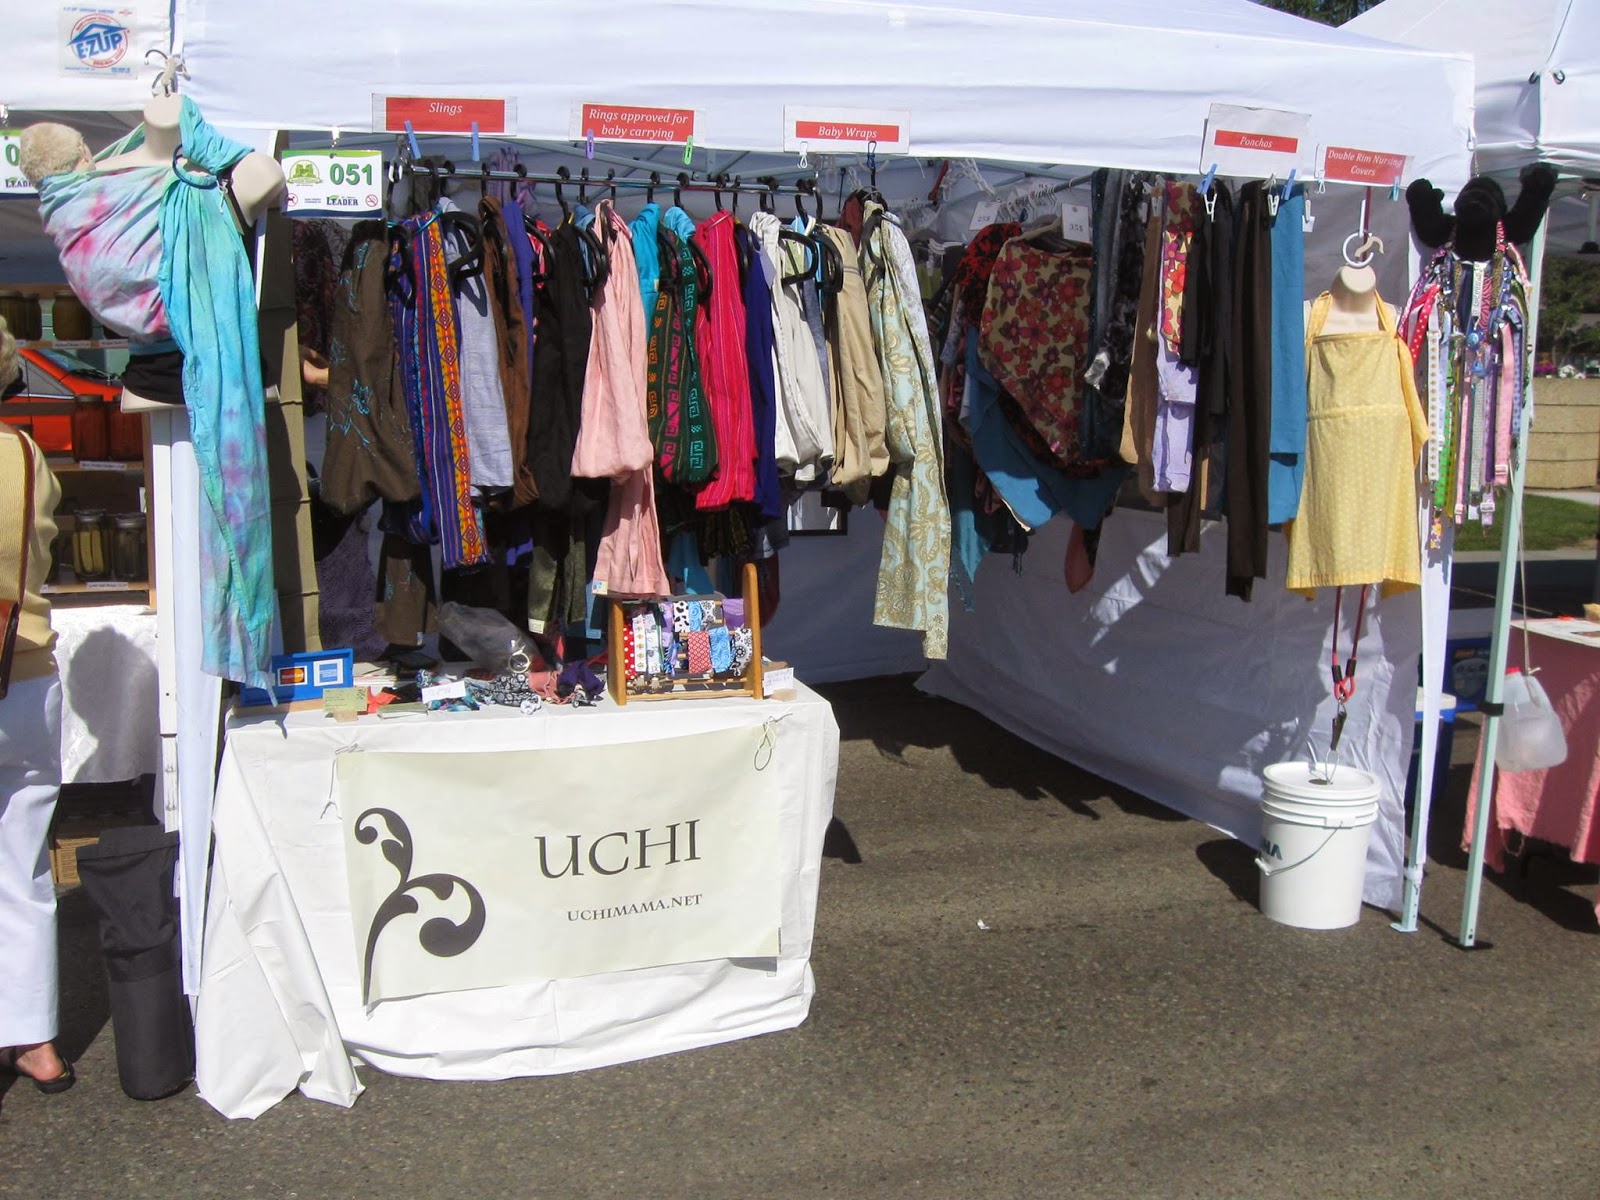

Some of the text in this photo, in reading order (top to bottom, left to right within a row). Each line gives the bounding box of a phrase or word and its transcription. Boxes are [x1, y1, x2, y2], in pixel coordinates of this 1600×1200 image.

[429, 102, 463, 116] Slings
[589, 108, 688, 126] Rings approved for
[601, 125, 674, 140] baby carrying
[818, 126, 878, 140] Baby Wraps
[1239, 136, 1273, 148] Ponchos
[1328, 150, 1403, 168] Double Rim Nursing
[330, 163, 373, 186] 051
[1350, 165, 1377, 176] Covers
[326, 195, 359, 206] LEADER
[534, 819, 701, 879] UCHI
[567, 894, 703, 922] UCHIMAMA.NET
